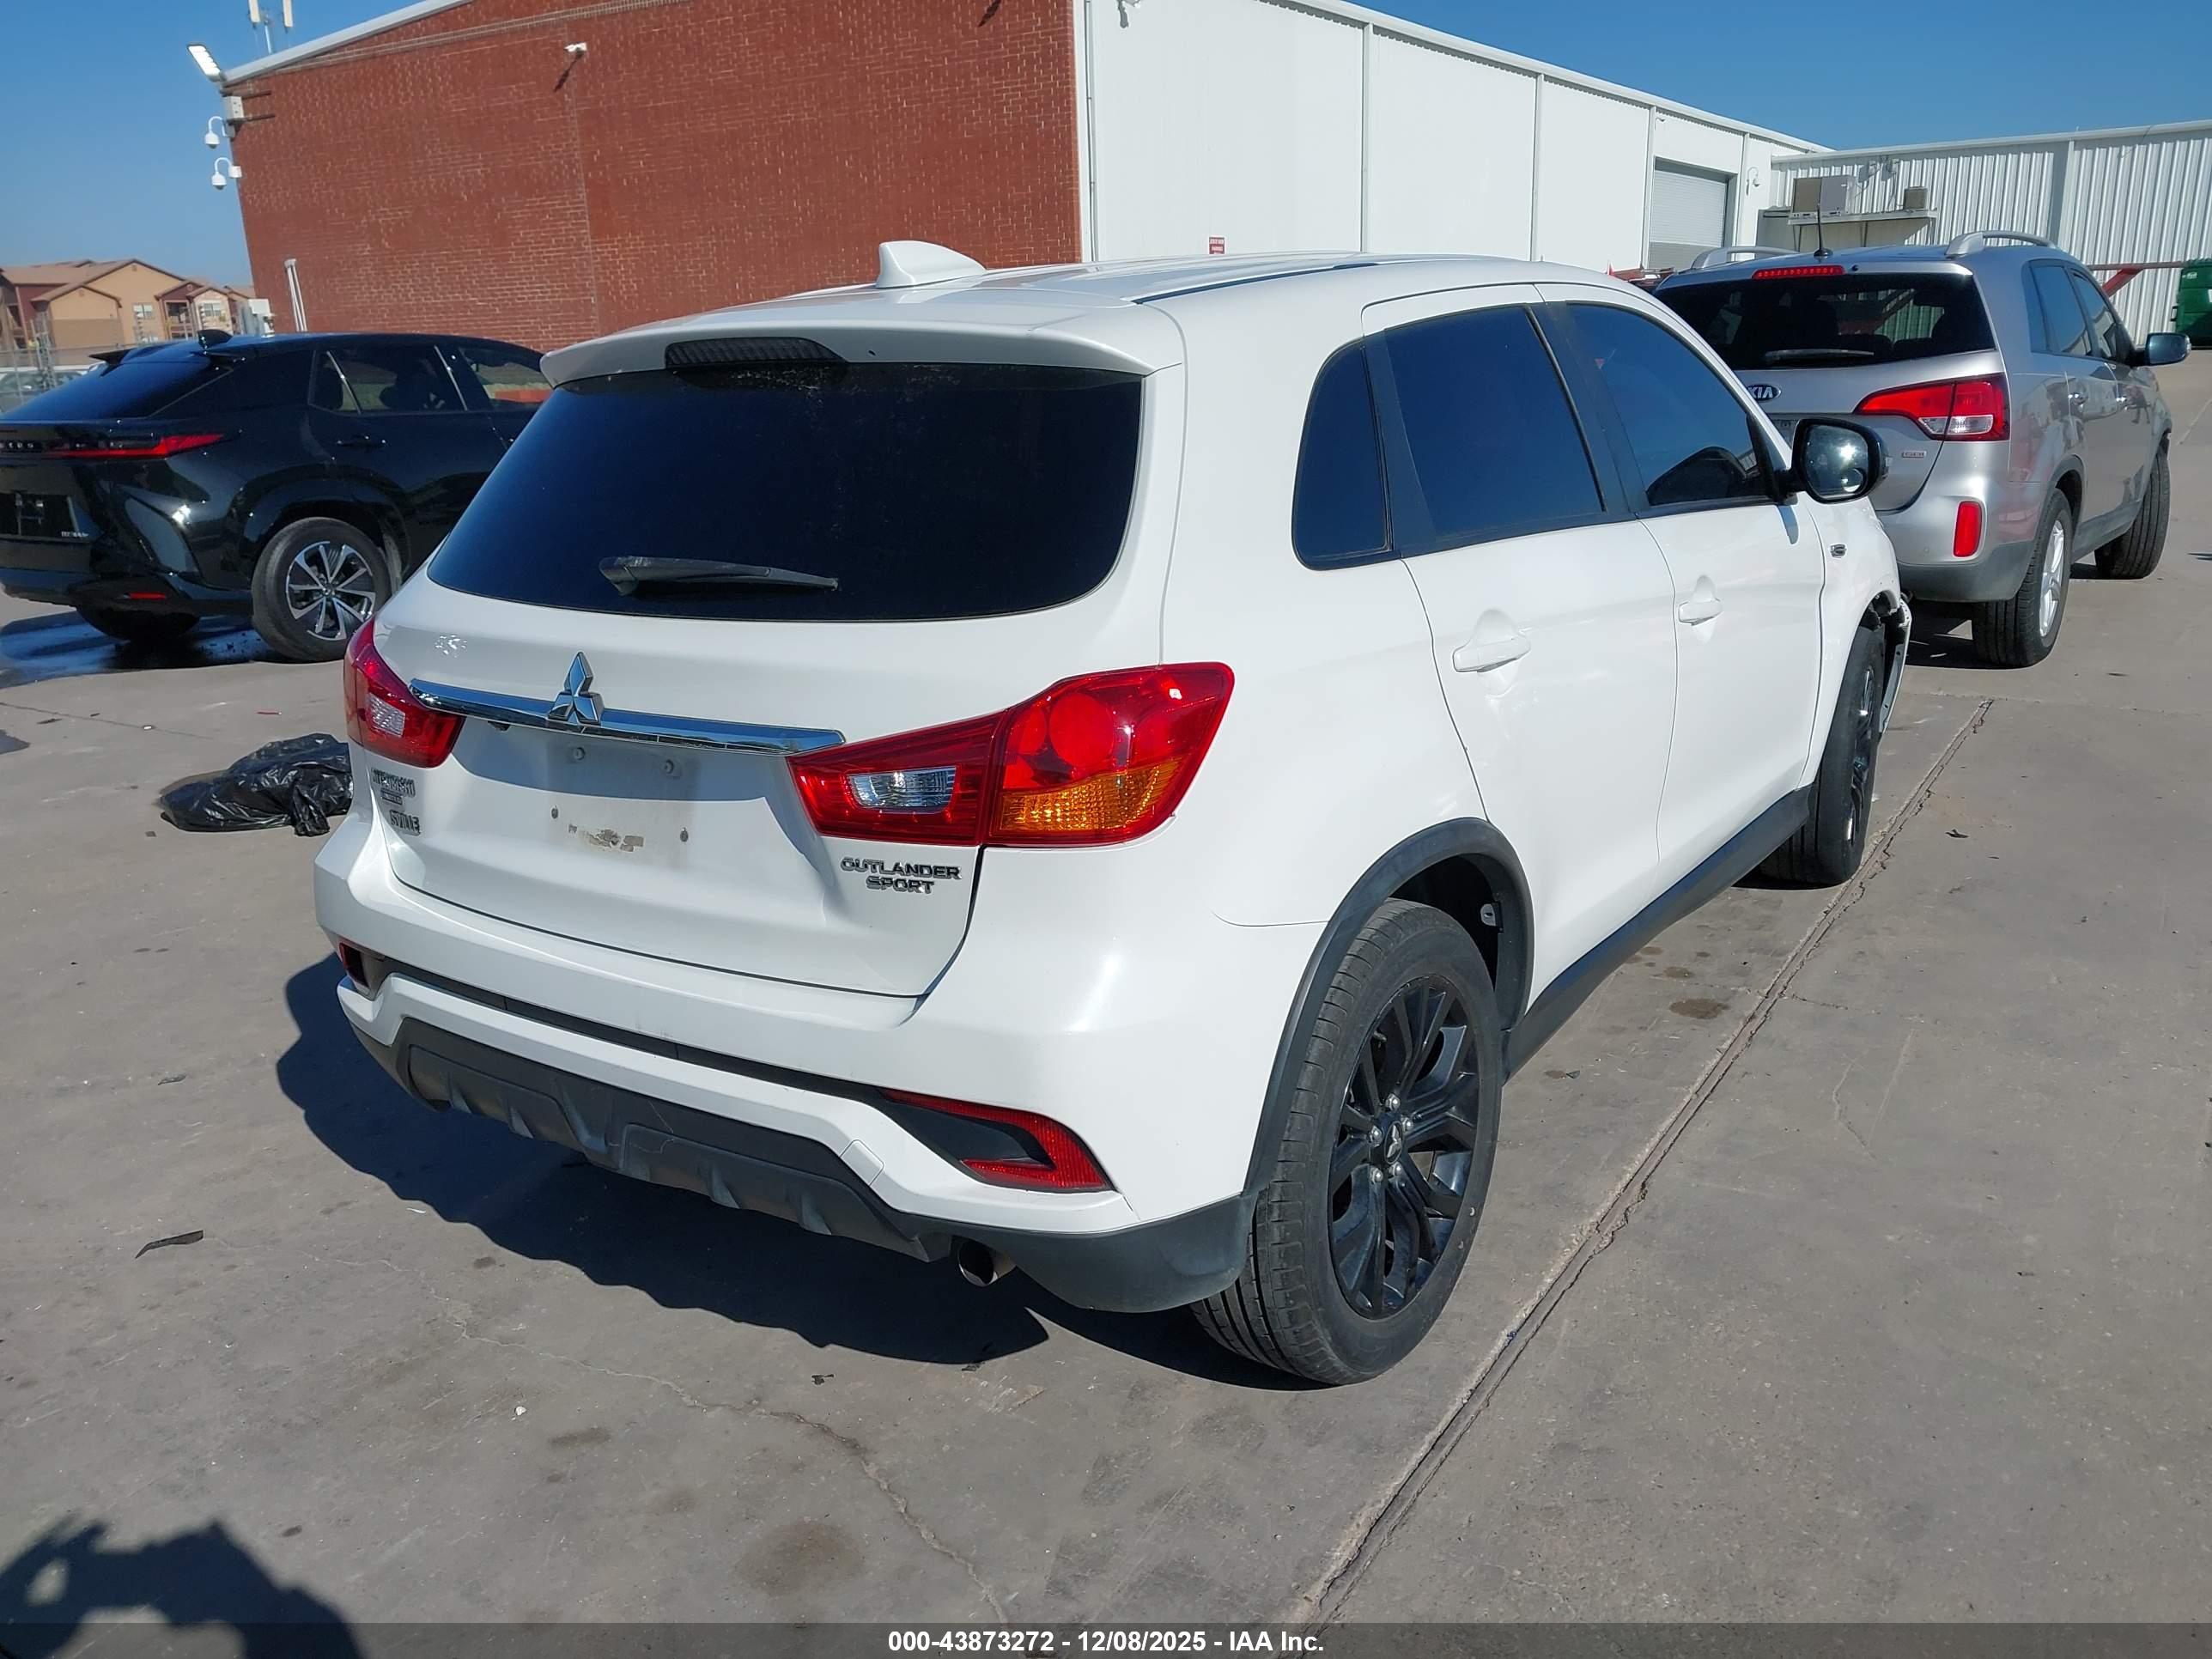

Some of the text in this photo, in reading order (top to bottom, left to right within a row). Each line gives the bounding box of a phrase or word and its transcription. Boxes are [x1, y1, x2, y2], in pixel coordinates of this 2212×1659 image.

[1747, 386, 1774, 399] KIA
[840, 856, 963, 880] OUTLANDER
[866, 875, 935, 895] SPORT
